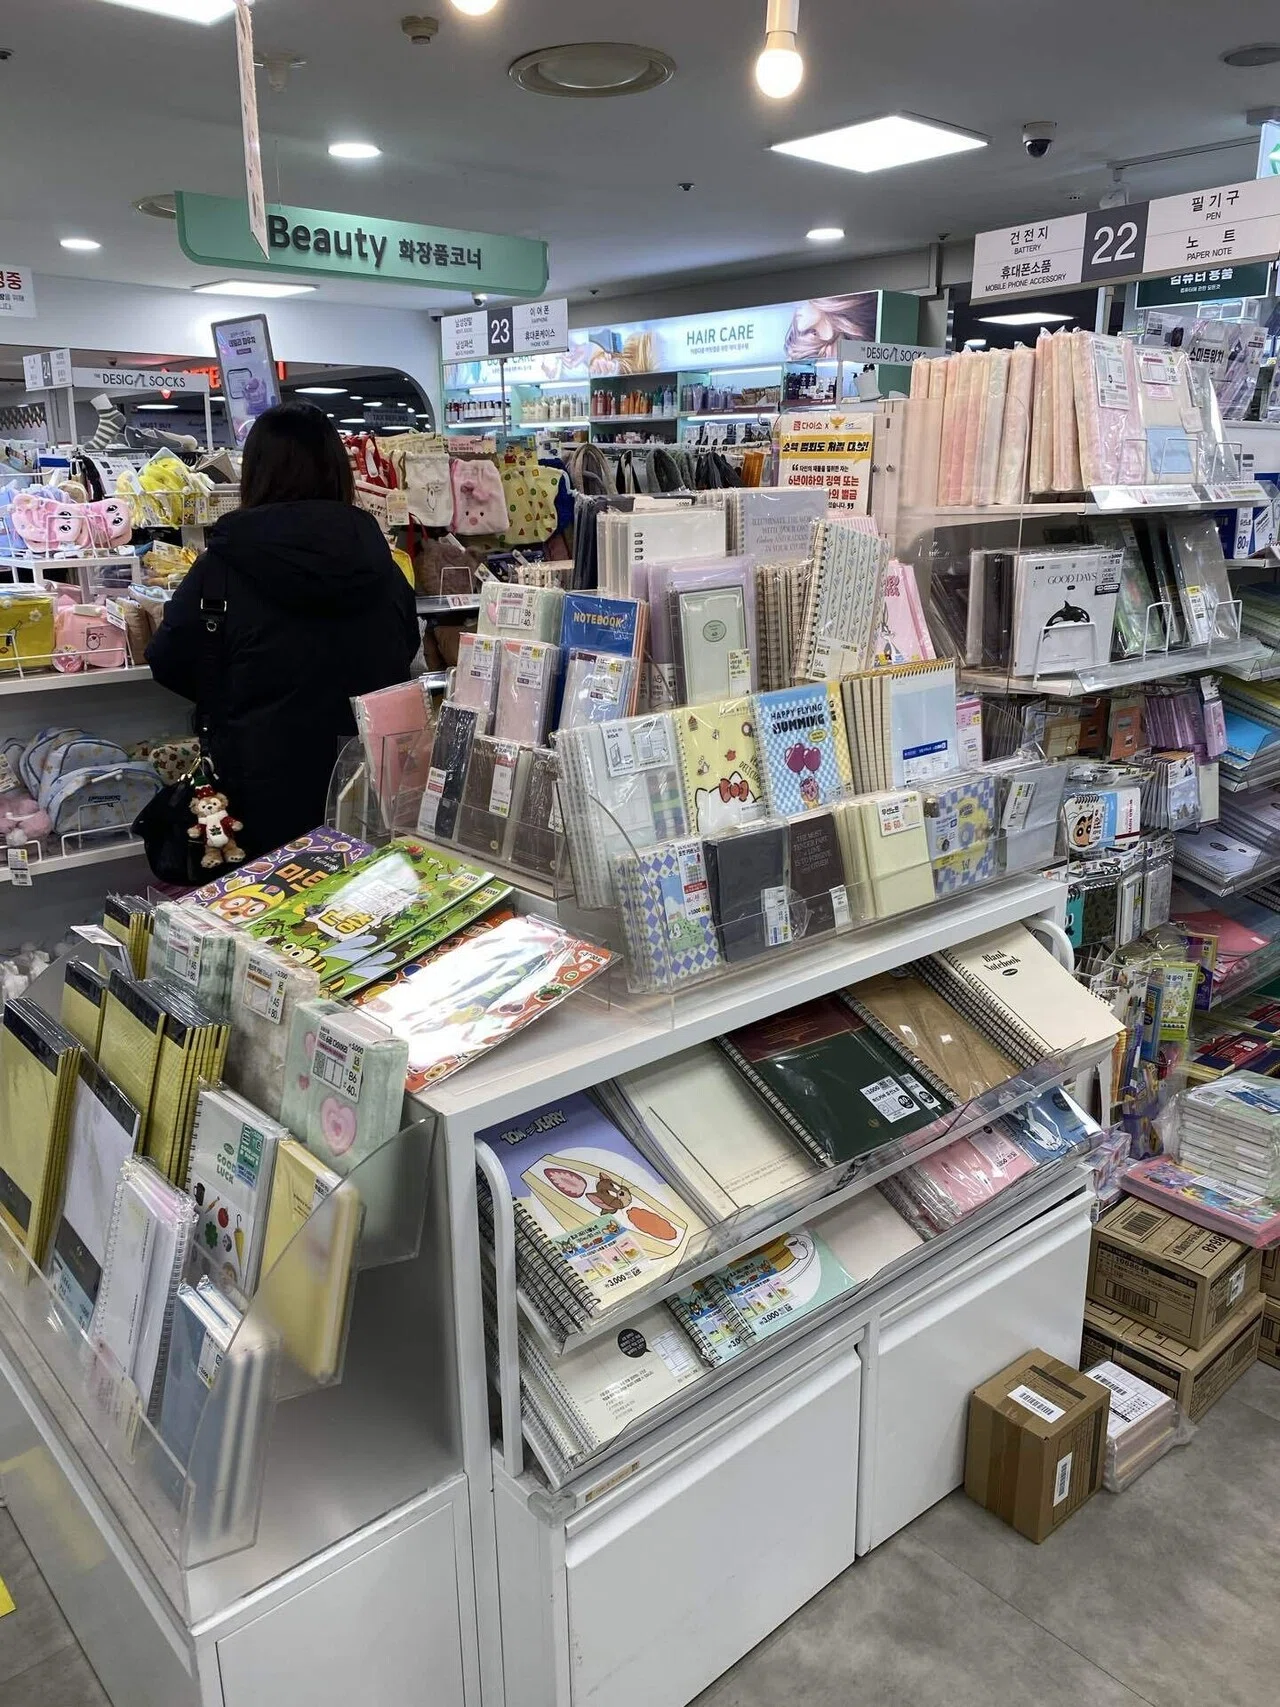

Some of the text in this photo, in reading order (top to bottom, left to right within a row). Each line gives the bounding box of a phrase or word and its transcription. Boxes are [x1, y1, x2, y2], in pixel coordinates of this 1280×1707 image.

[1191, 190, 1240, 212] 필기구
[1206, 211, 1221, 221] PEN
[267, 214, 483, 271] Beauty 화장품코너
[1010, 225, 1049, 246] 건전지
[1091, 221, 1138, 265] 22
[1014, 243, 1042, 255] BATTERY
[1186, 247, 1233, 262] PAPER NOTE
[1000, 259, 1052, 280] 휴대폰소품
[985, 272, 1067, 293] MOBILE PHONE ACCESSORY
[490, 318, 511, 344] 23
[525, 328, 556, 341] 휴대폰케이스
[686, 323, 755, 346] HAIR CARE
[1189, 347, 1225, 364] 스마트워치
[149, 375, 186, 388] SOCKS
[802, 422, 823, 430] 다이소
[788, 475, 859, 487] 6년이하의 징역 또는
[842, 489, 857, 500] 벌금
[1047, 572, 1098, 585] GOOD DAYS
[573, 611, 623, 628] NOTEBOOK
[770, 703, 823, 720] HAPPY FLYING
[982, 950, 1007, 963] Blank
[501, 1127, 527, 1146] TOM
[534, 1109, 568, 1134] JERRY
[216, 1153, 236, 1175] GOOD
[216, 1164, 234, 1185] LUCK
